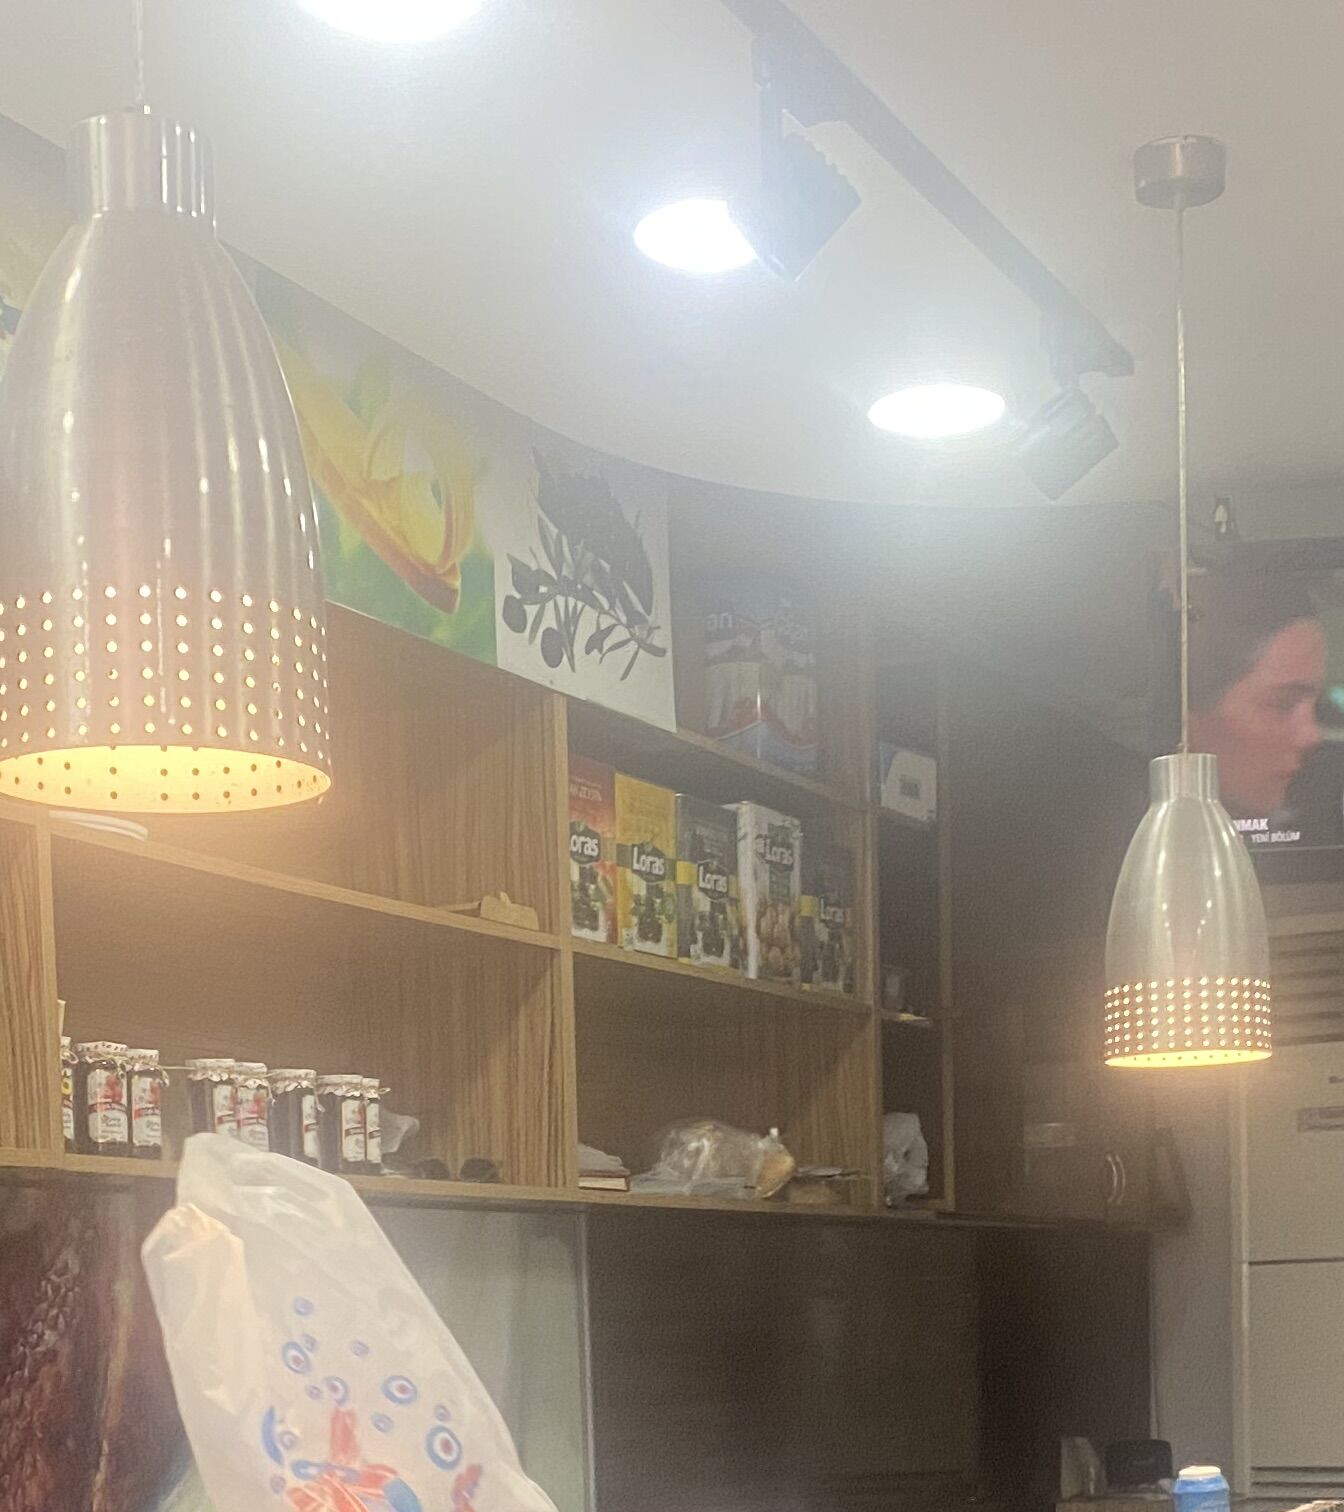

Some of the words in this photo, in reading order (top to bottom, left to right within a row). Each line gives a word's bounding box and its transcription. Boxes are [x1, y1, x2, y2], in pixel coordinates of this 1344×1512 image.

[570, 834, 599, 857] oras
[632, 846, 665, 875] Loras
[698, 867, 727, 893] Loras
